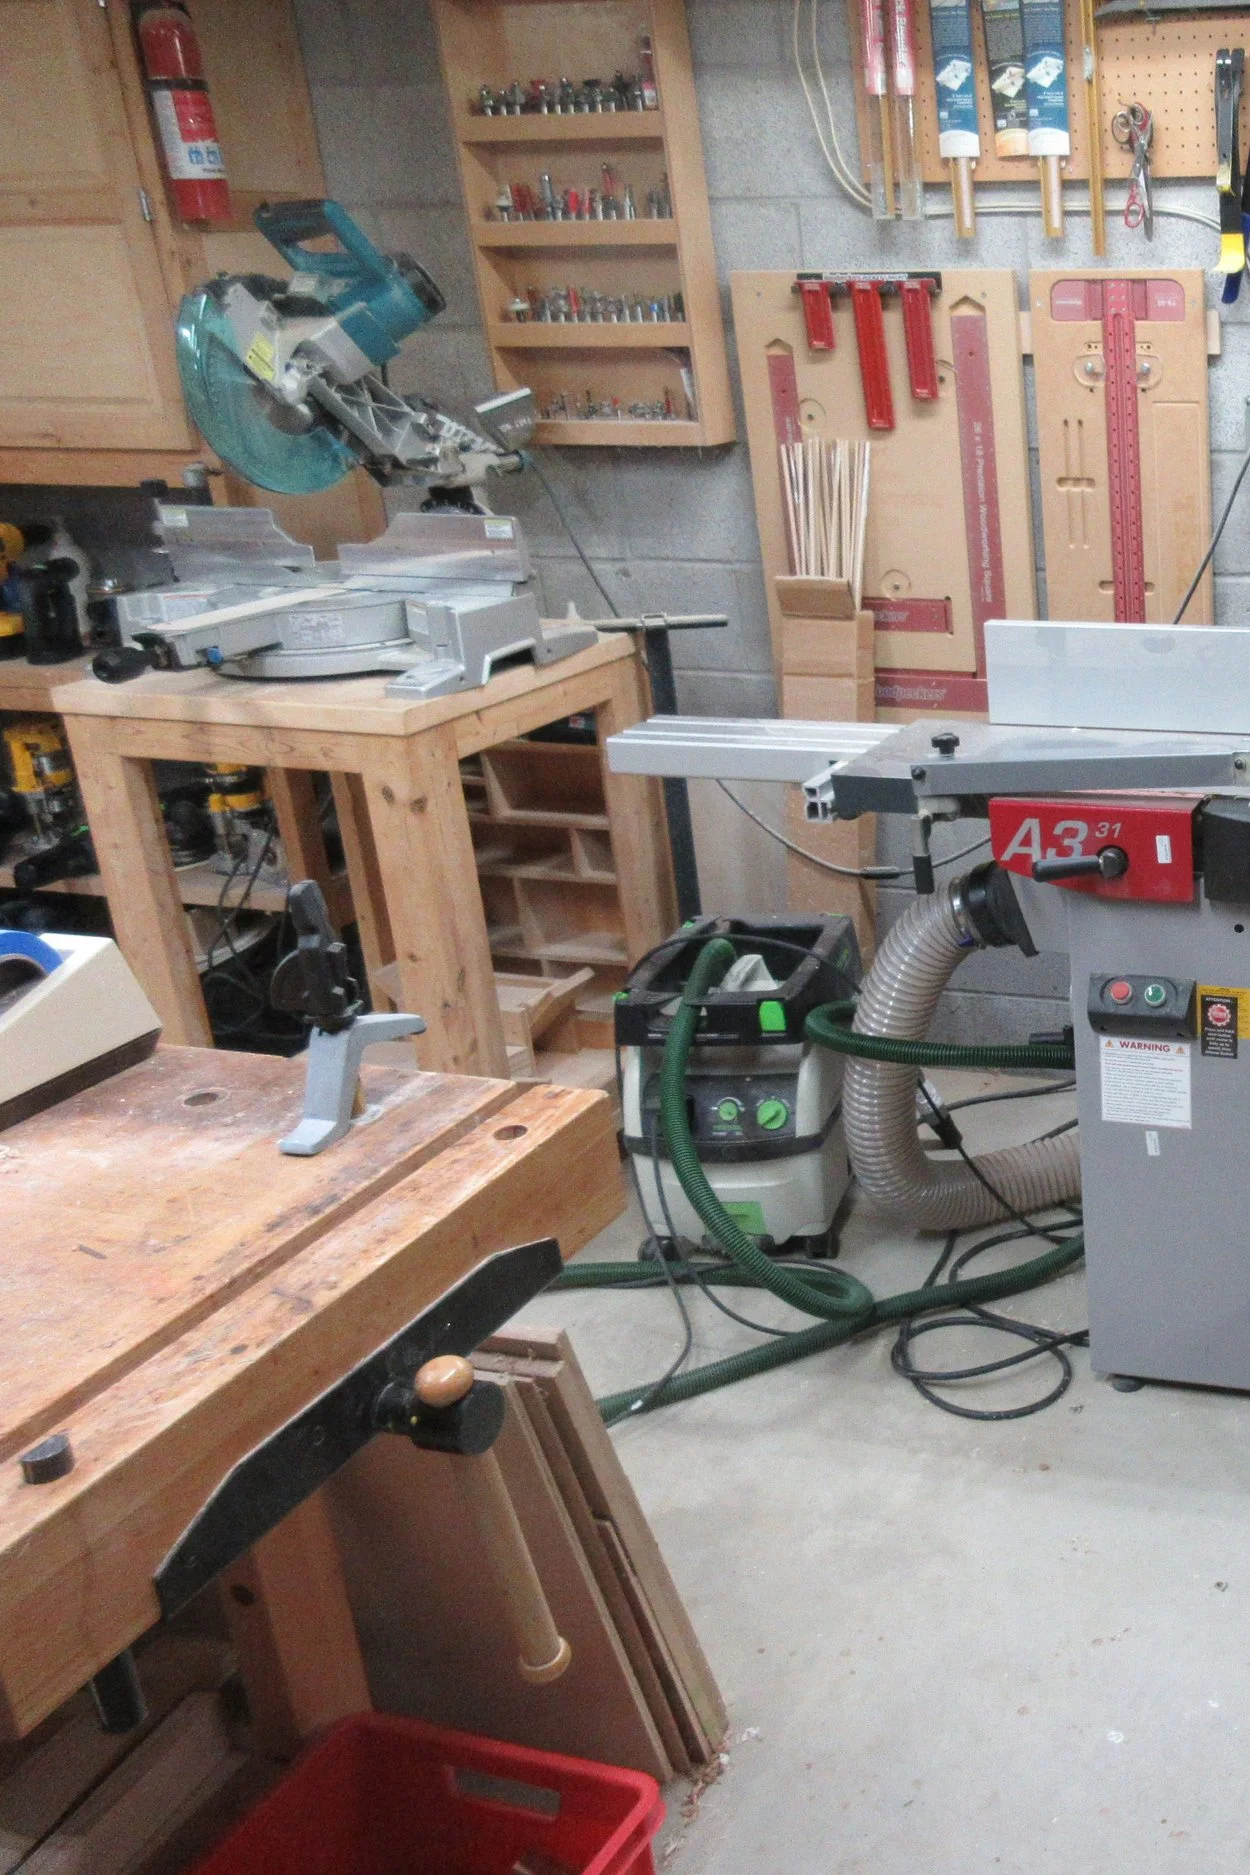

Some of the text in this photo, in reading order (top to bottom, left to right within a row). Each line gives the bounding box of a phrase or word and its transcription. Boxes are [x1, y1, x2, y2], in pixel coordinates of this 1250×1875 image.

[979, 504, 991, 569] Woodworking
[1001, 818, 1122, 862] A3 31
[1119, 1041, 1171, 1053] WARNING
